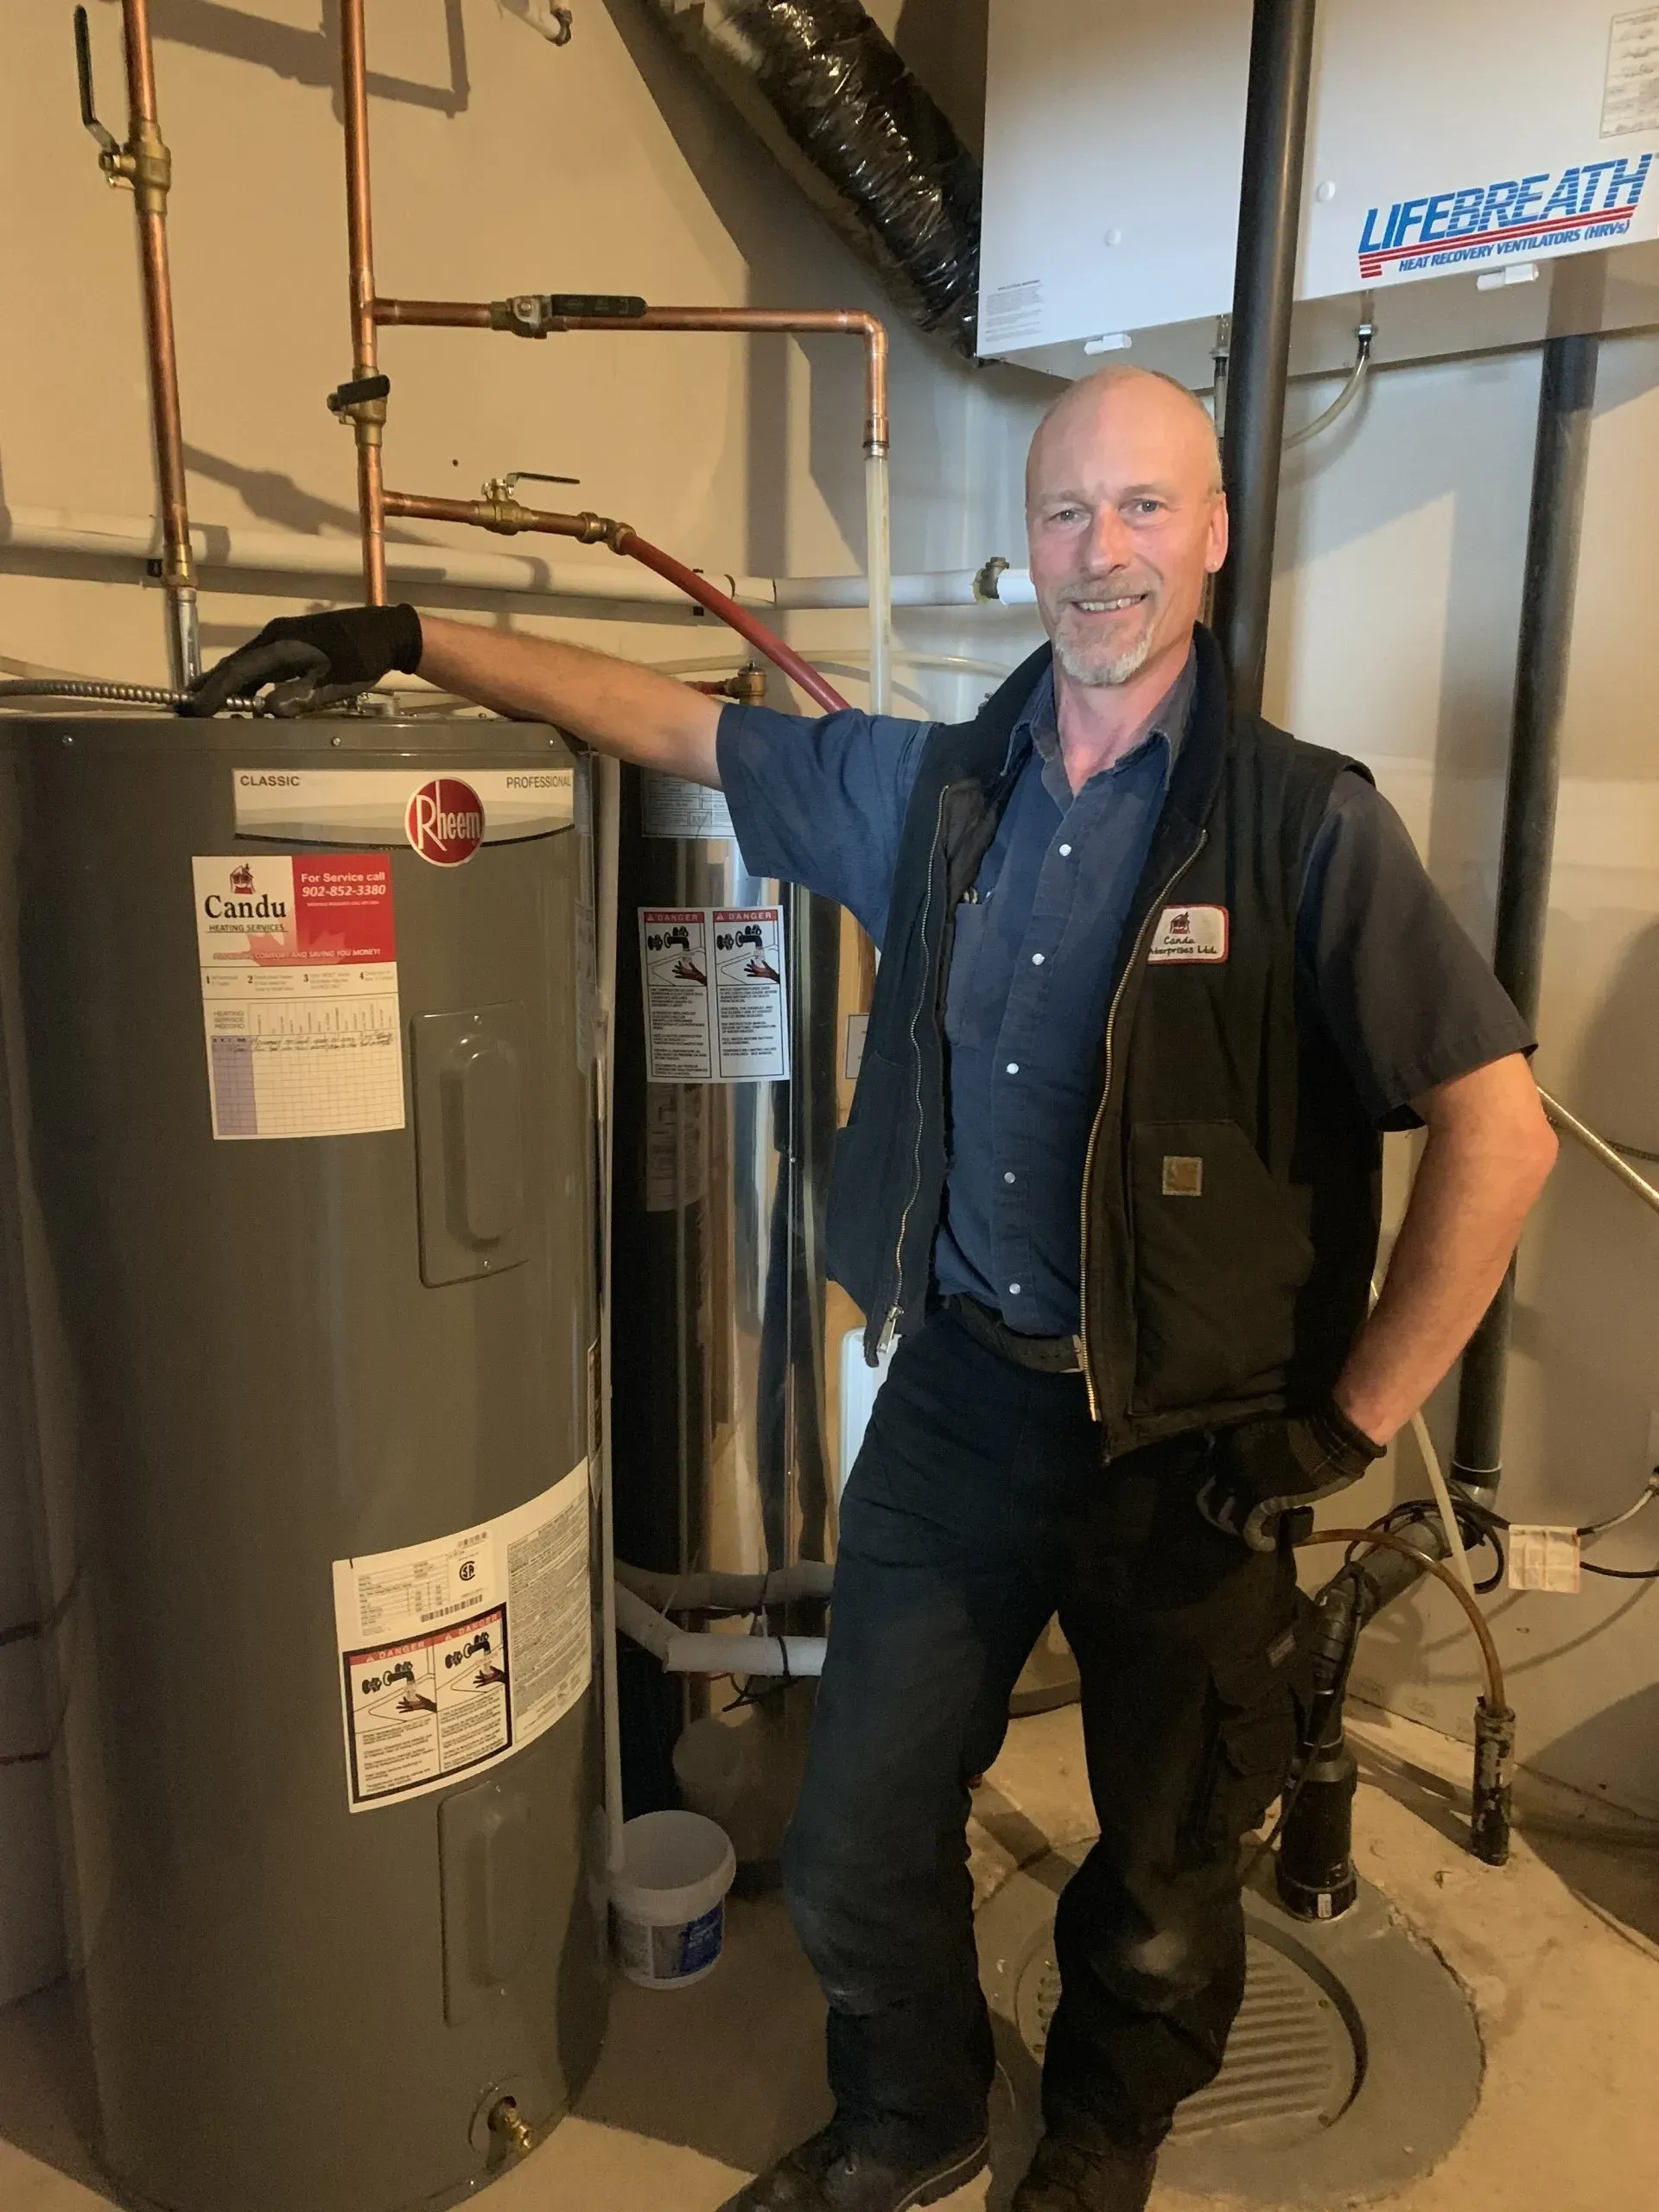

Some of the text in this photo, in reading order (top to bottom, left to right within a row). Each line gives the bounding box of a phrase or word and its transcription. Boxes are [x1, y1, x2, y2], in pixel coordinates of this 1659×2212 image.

[1358, 153, 1652, 253] LIFEBREATH
[1399, 219, 1630, 272] HEAT RECOVERY VENTILATORS (HRVs)
[240, 776, 300, 787] CLASSIC
[506, 775, 571, 789] PROFESSIONAL
[416, 780, 480, 851] Rheem
[301, 871, 385, 883] For Service call
[302, 884, 386, 897] 902-852-3380
[205, 893, 287, 918] Candu
[1163, 936, 1196, 944] Candu
[1150, 946, 1194, 957] nterprises
[458, 1613, 499, 1636] DANGER
[378, 1642, 425, 1658] DANGER
